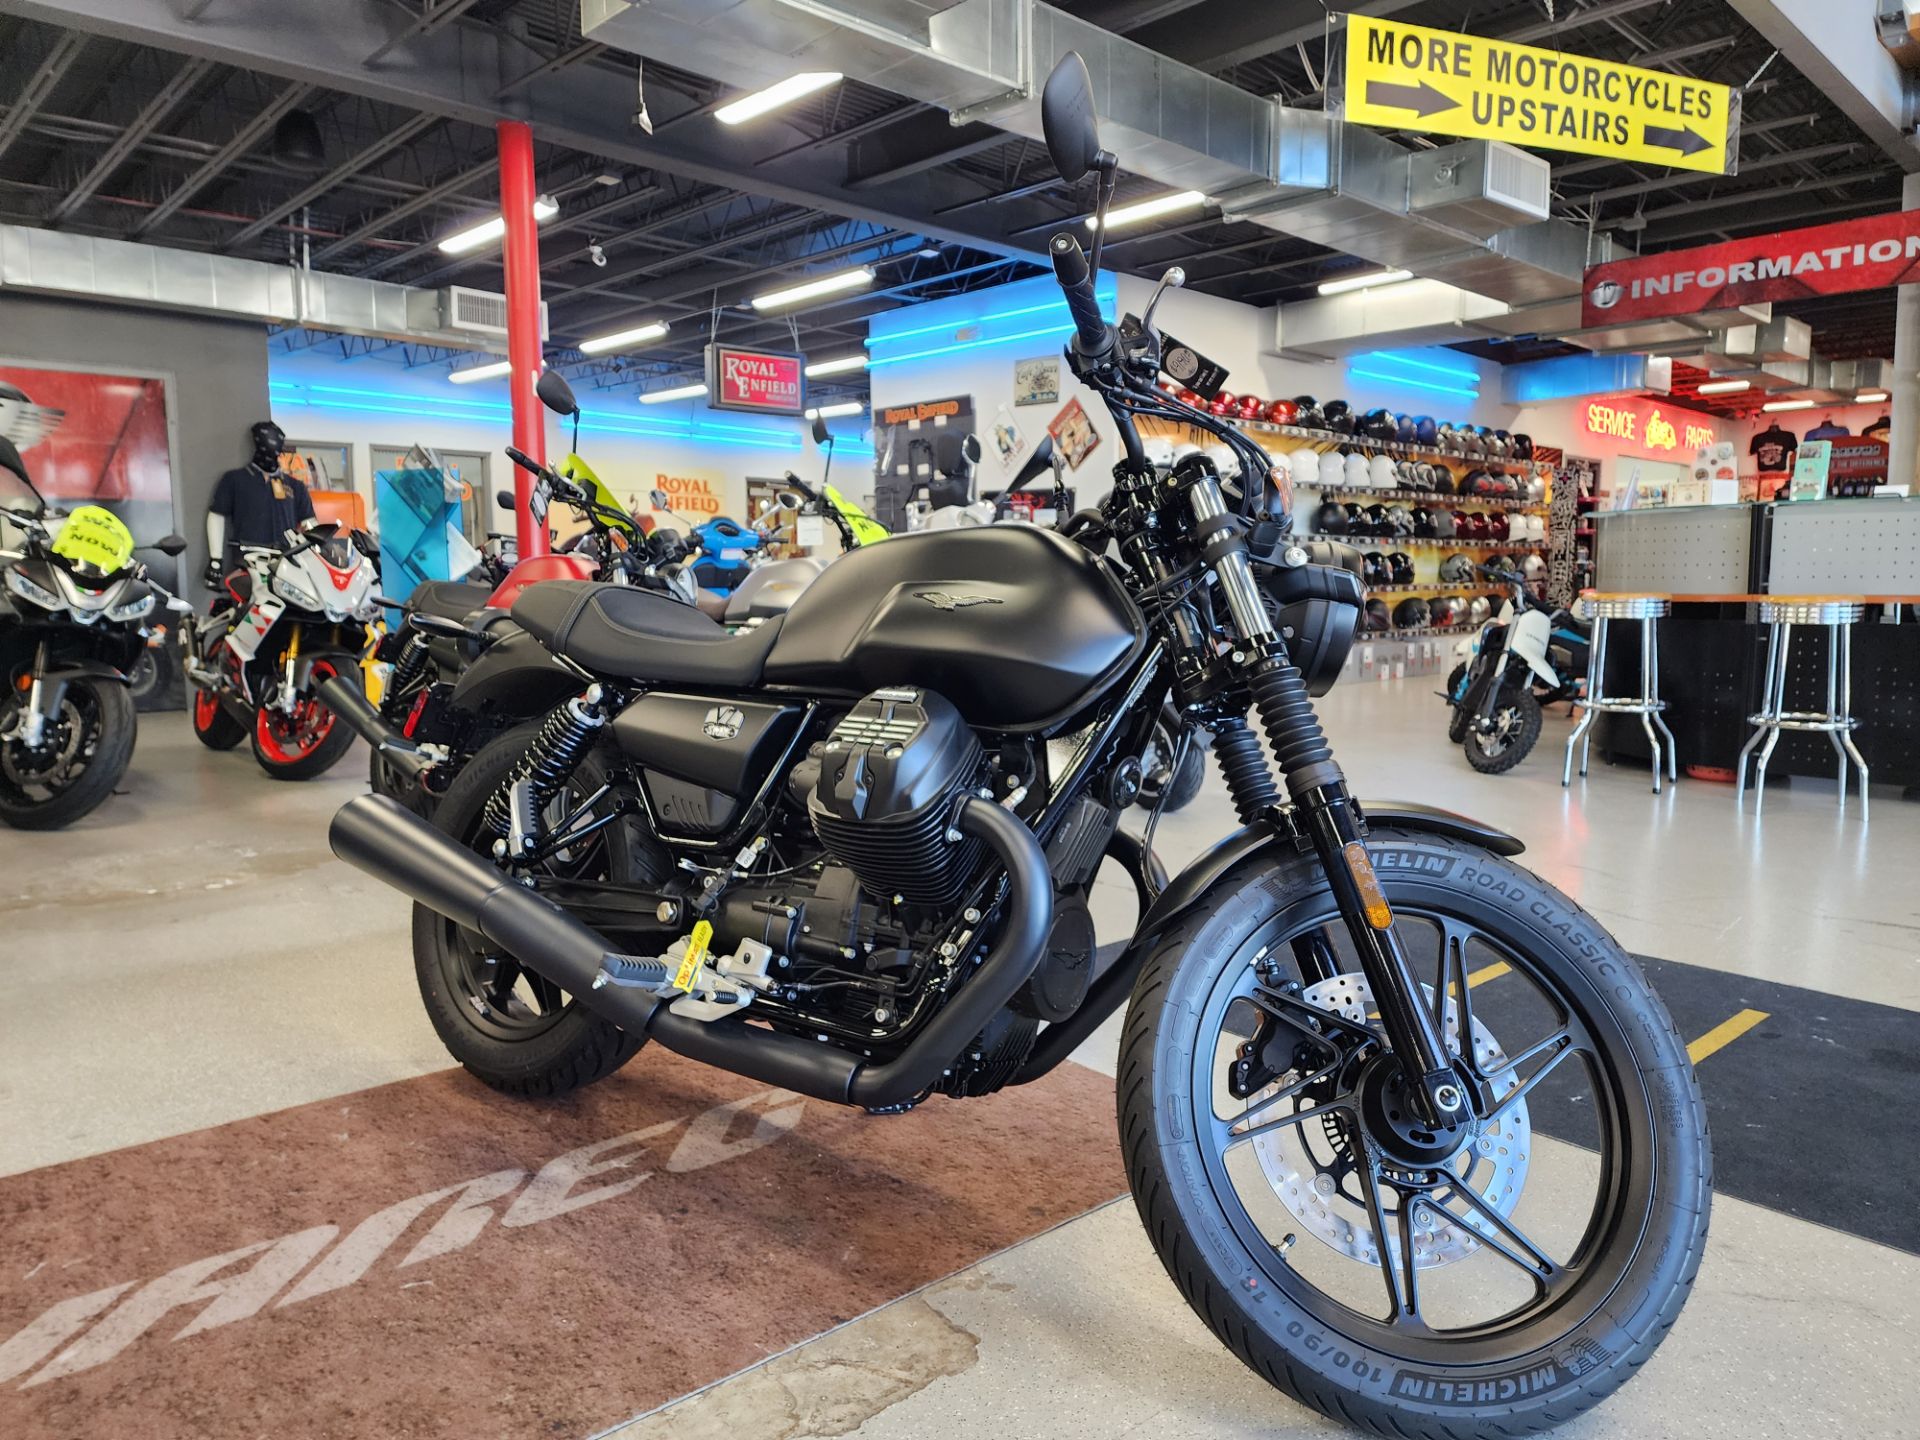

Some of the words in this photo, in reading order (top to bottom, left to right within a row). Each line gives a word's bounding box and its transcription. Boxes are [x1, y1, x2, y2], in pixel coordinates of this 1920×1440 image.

[1368, 27, 1472, 78] MORE
[1487, 48, 1712, 120] MOTORCYCLES
[1472, 91, 1630, 146] UPSTAIRS
[725, 357, 778, 382] ROYAL
[738, 376, 797, 398] ENFIELD
[1588, 404, 1637, 440] SERVICE
[1685, 425, 1714, 449] PARTS
[652, 496, 719, 515] FIELD
[656, 473, 712, 496] ROYAL
[1458, 866, 1526, 903] ROAD
[1530, 899, 1617, 978] CLASSIC
[1286, 1319, 1383, 1384] 100/90
[1398, 1363, 1558, 1402] MICHELIN
